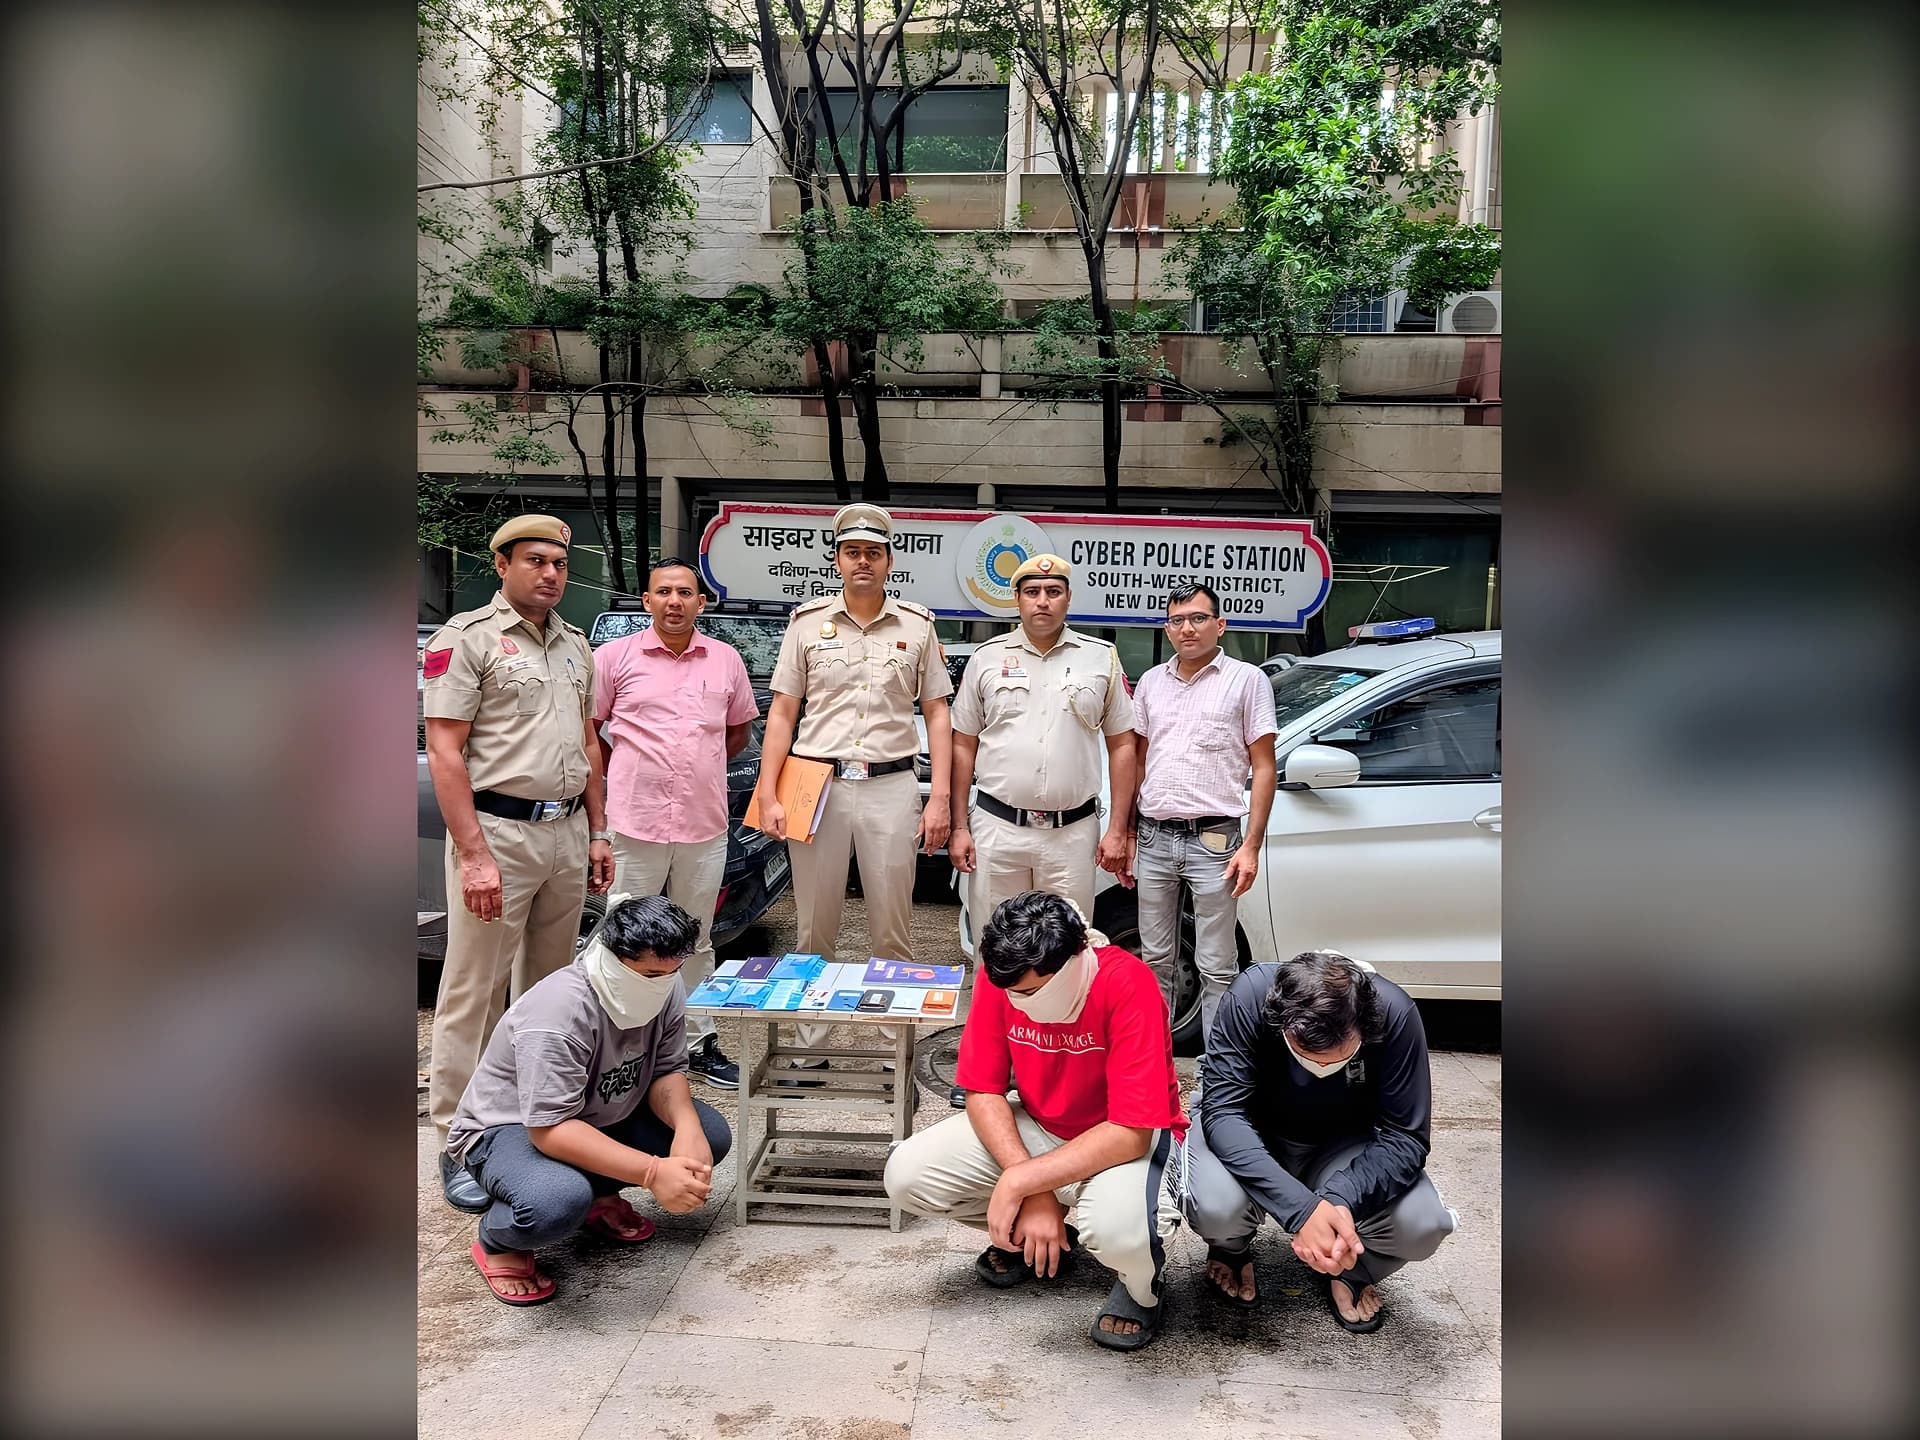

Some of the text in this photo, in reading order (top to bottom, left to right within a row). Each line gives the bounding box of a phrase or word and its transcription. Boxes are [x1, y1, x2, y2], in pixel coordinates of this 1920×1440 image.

[742, 526, 817, 551] साइबर
[892, 532, 944, 555] थाना
[1071, 540, 1306, 573] CYBER POLICE STATION
[781, 580, 807, 598] नई
[1087, 571, 1286, 597] SOUTH-WEST DISTRICT,
[1104, 593, 1142, 610] NEW
[1008, 1023, 1053, 1047] ARMANI
